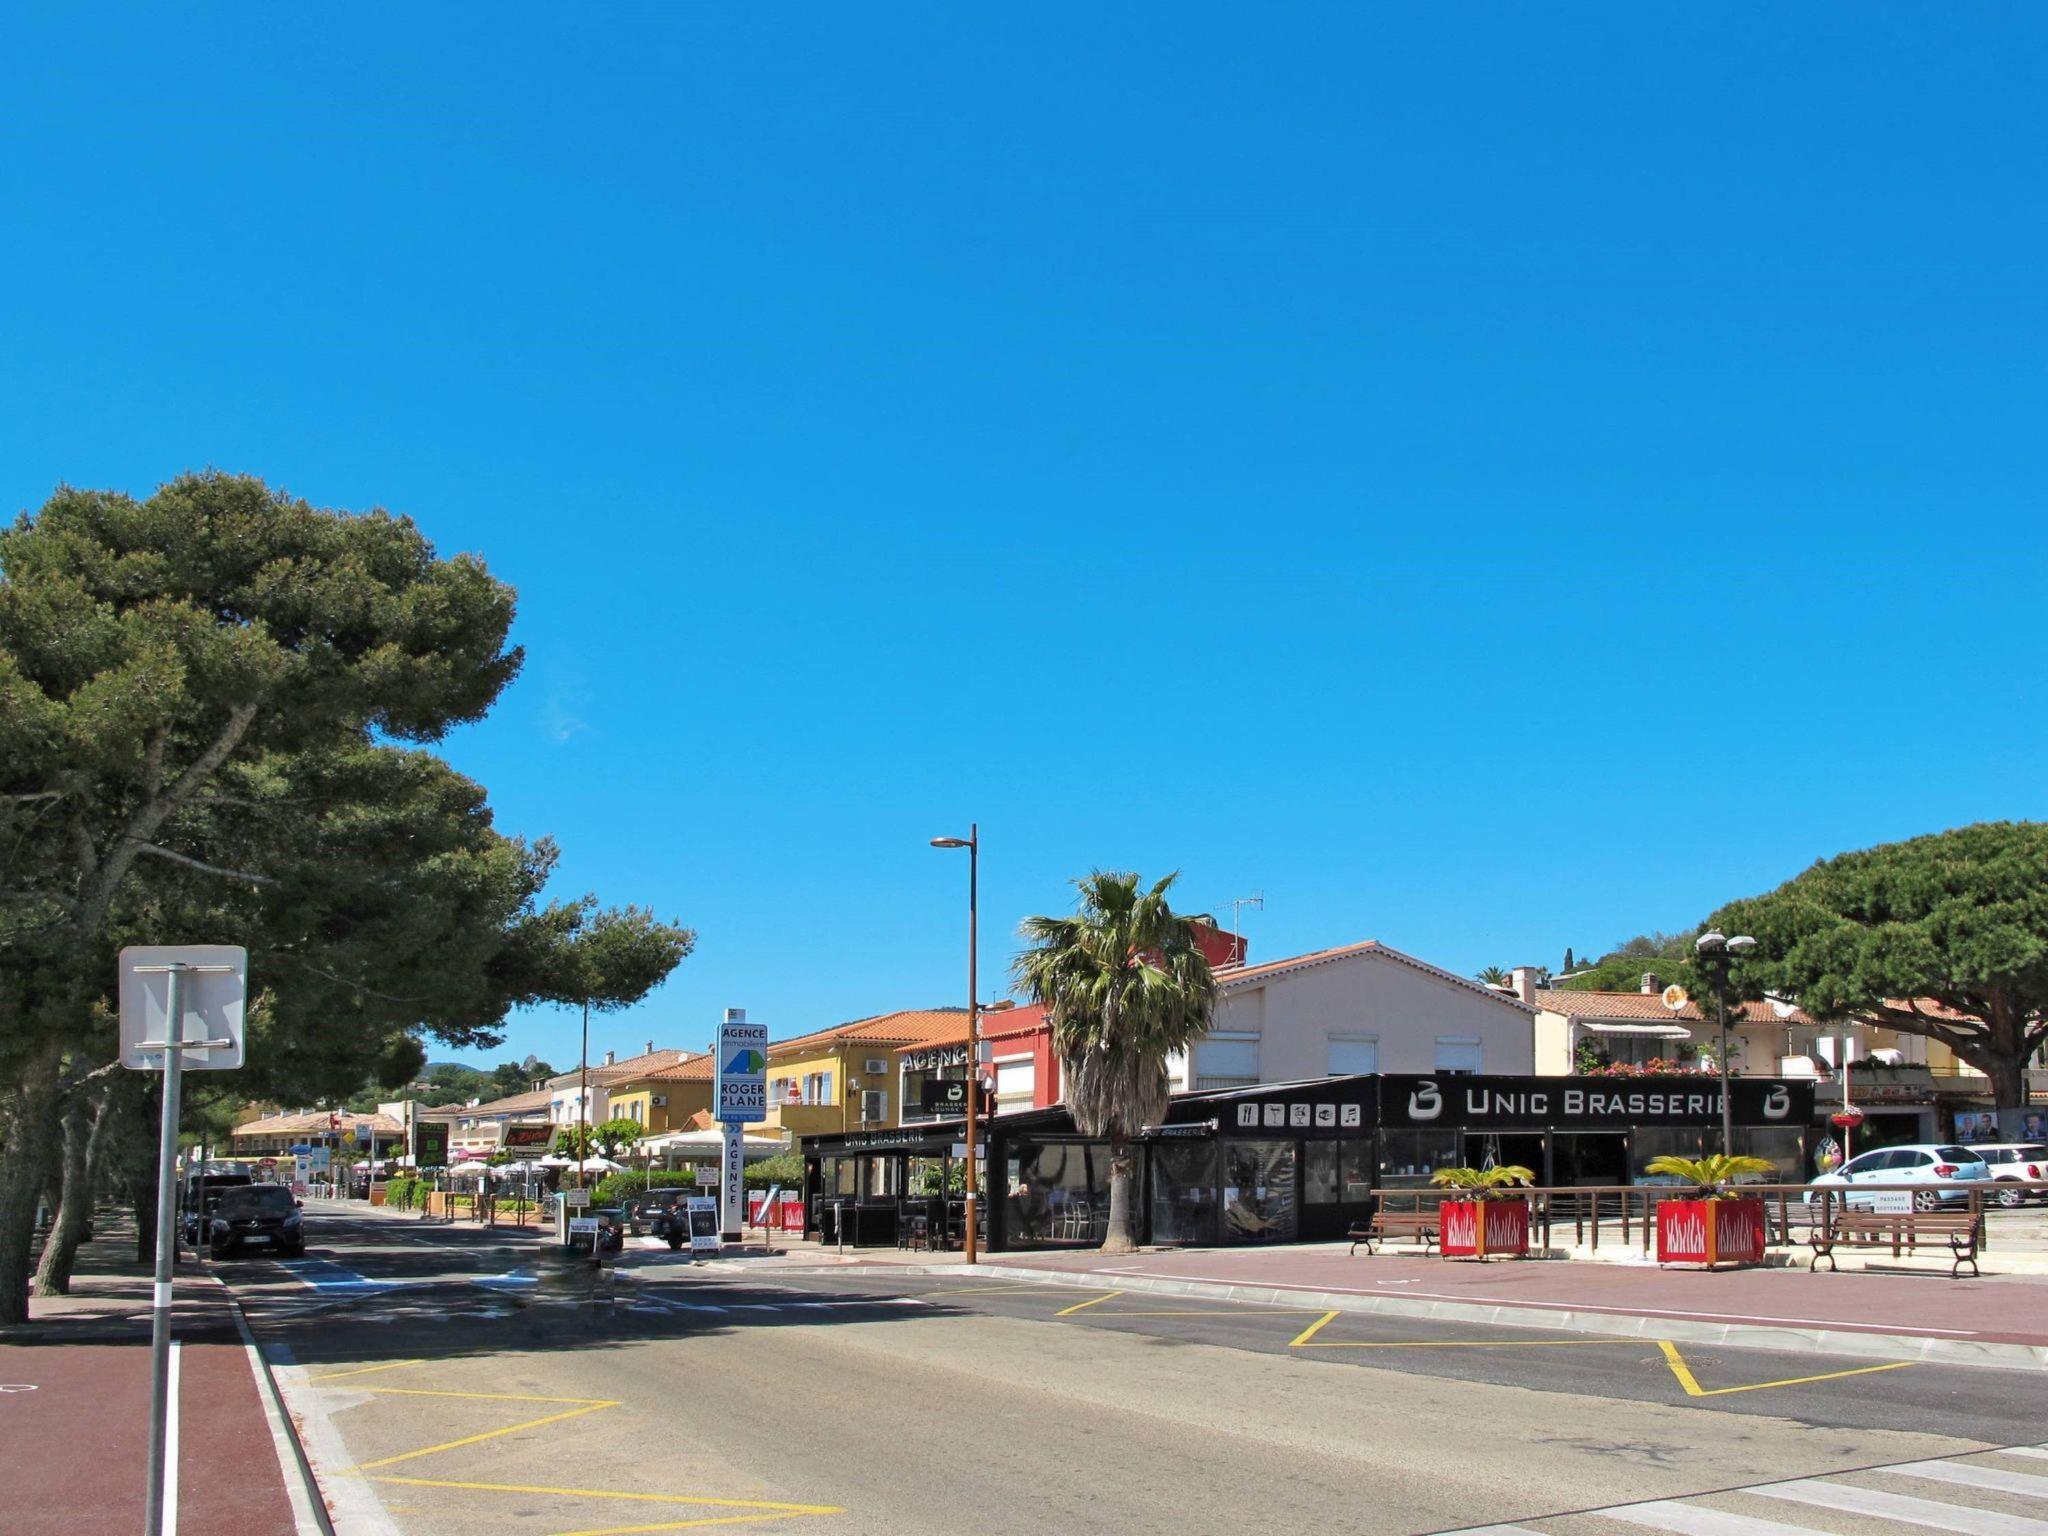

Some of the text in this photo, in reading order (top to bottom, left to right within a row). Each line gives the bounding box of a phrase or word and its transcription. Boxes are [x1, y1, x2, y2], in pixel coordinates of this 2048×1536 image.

[723, 1028, 765, 1038] AGENCE
[903, 1047, 968, 1069] AGENC
[722, 1083, 764, 1094] ROGER
[722, 1095, 764, 1106] PLANE
[730, 1139, 738, 1204] AGENCE
